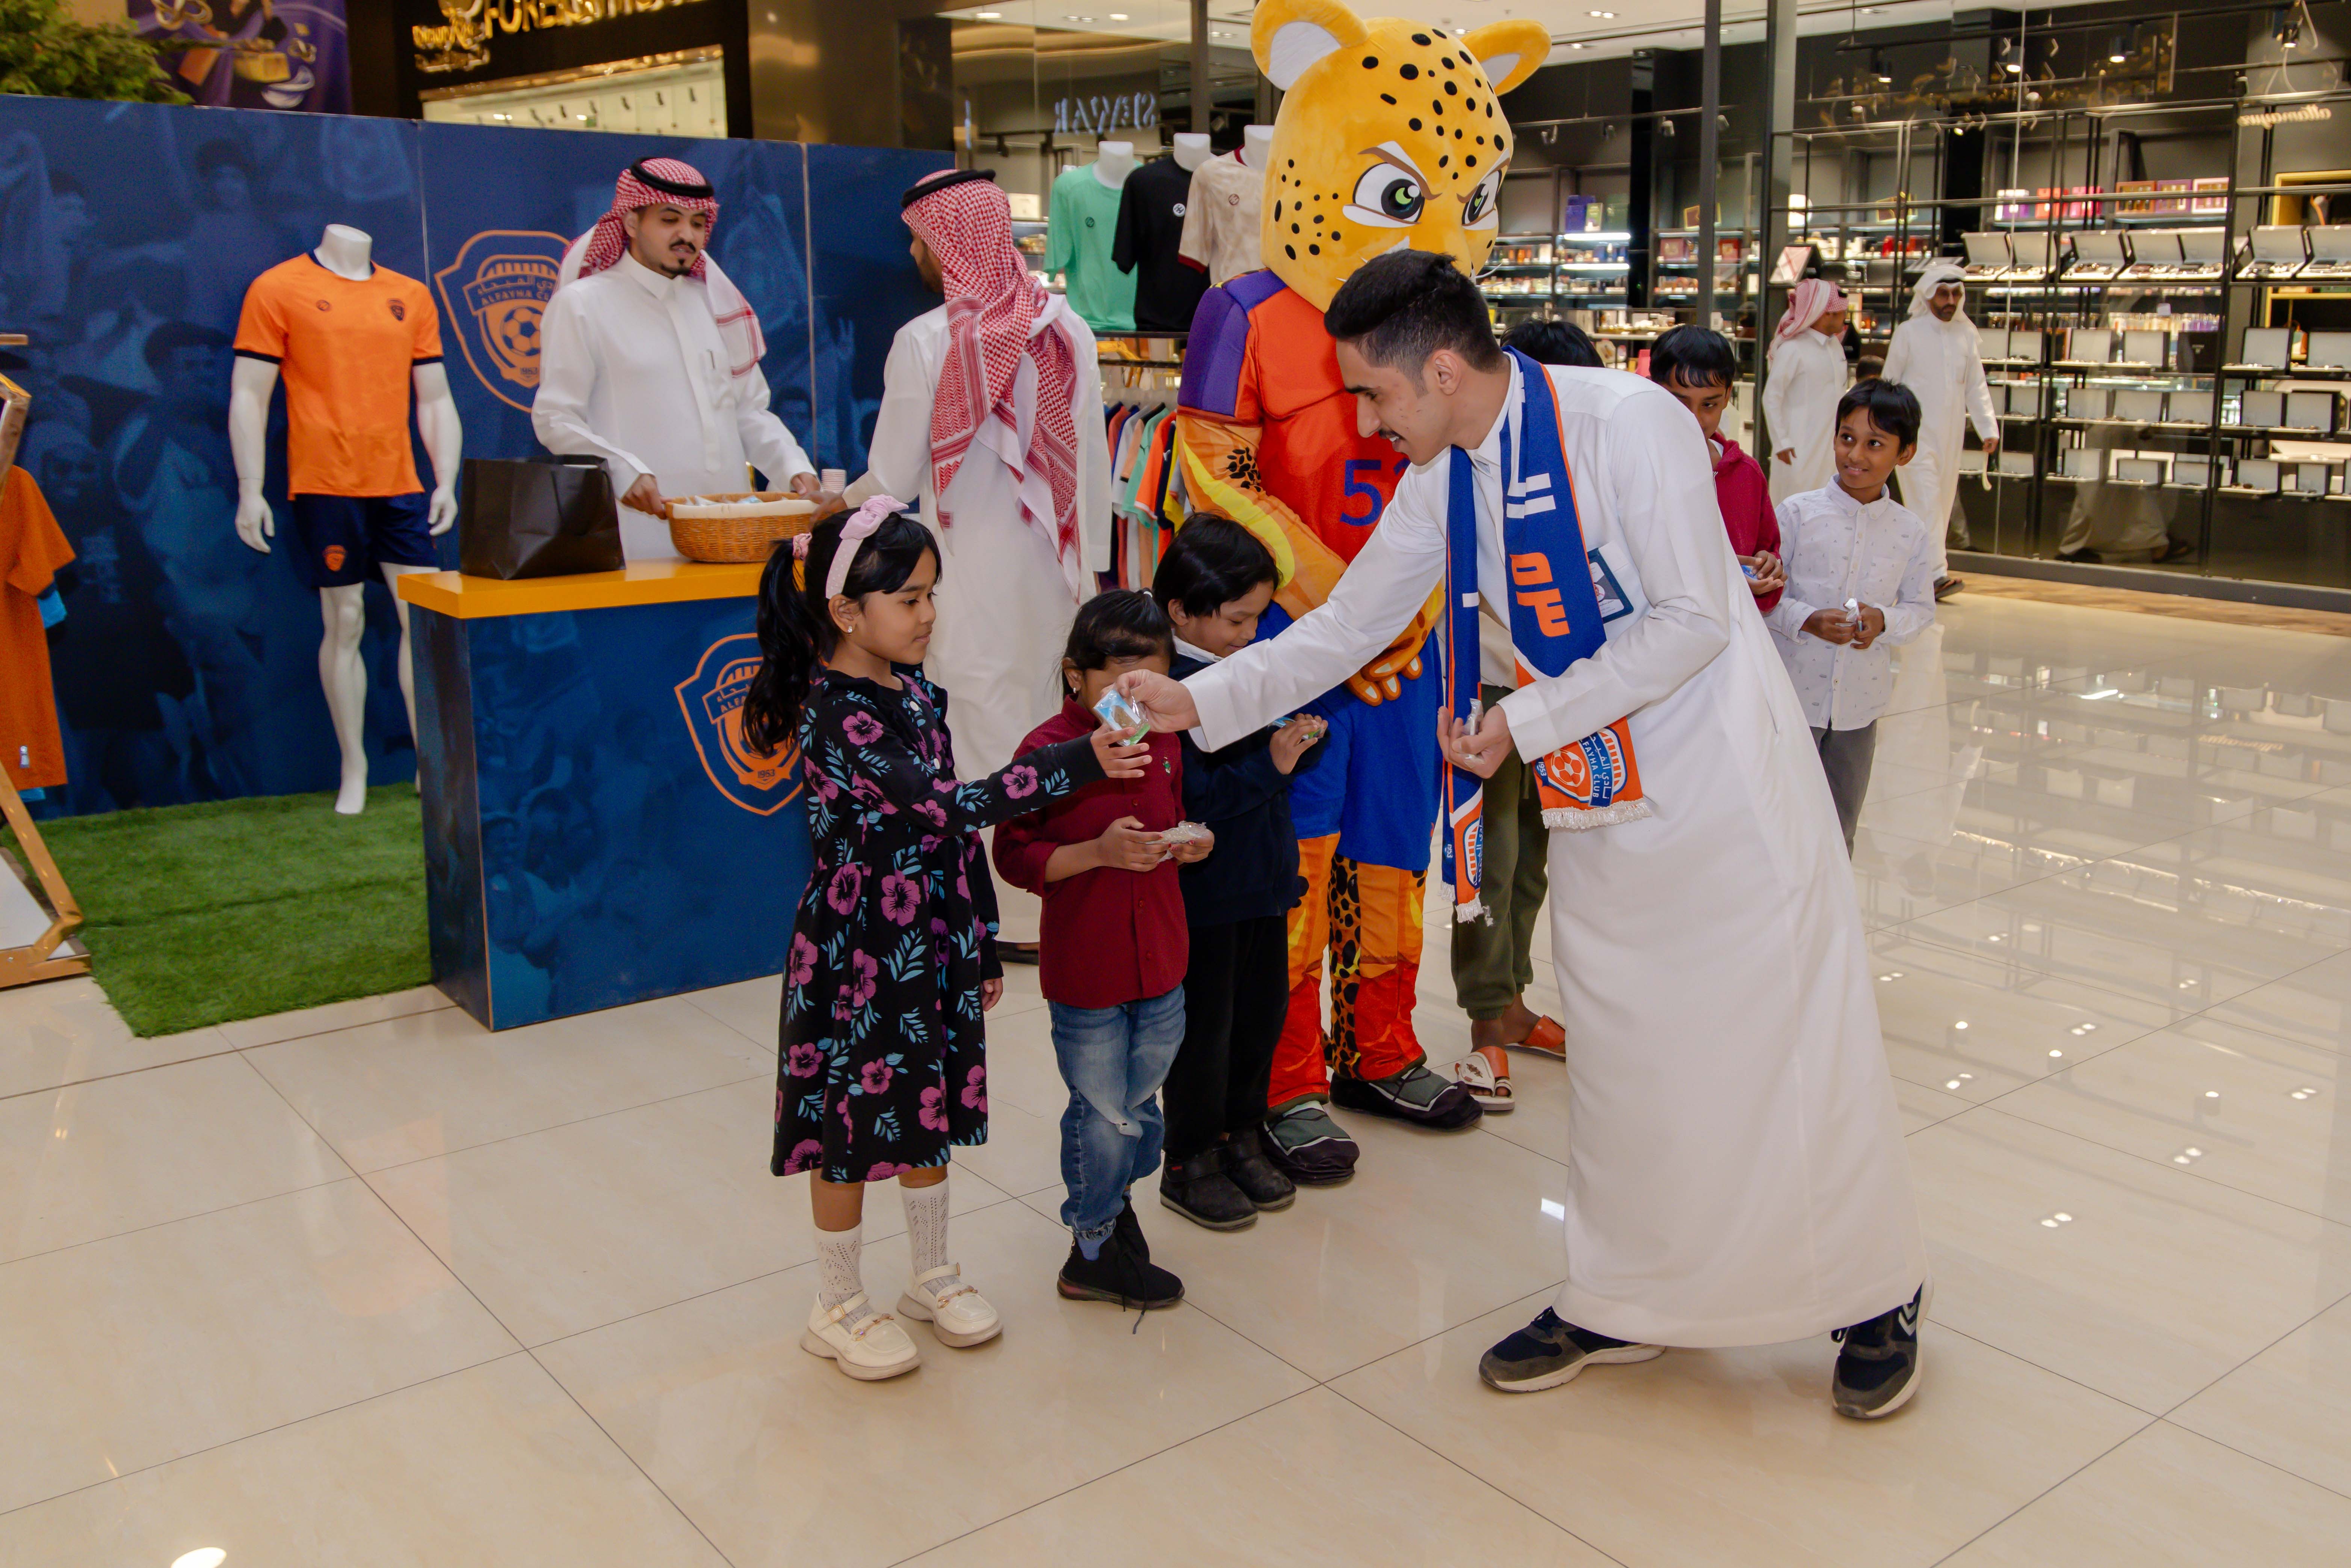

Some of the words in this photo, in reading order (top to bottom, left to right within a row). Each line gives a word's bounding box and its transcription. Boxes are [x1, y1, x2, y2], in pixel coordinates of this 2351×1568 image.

[481, 290, 532, 306] ALFAYHA
[757, 769, 775, 778] 1953
[1538, 761, 1547, 776] 1953
[1600, 772, 1612, 799] نادي
